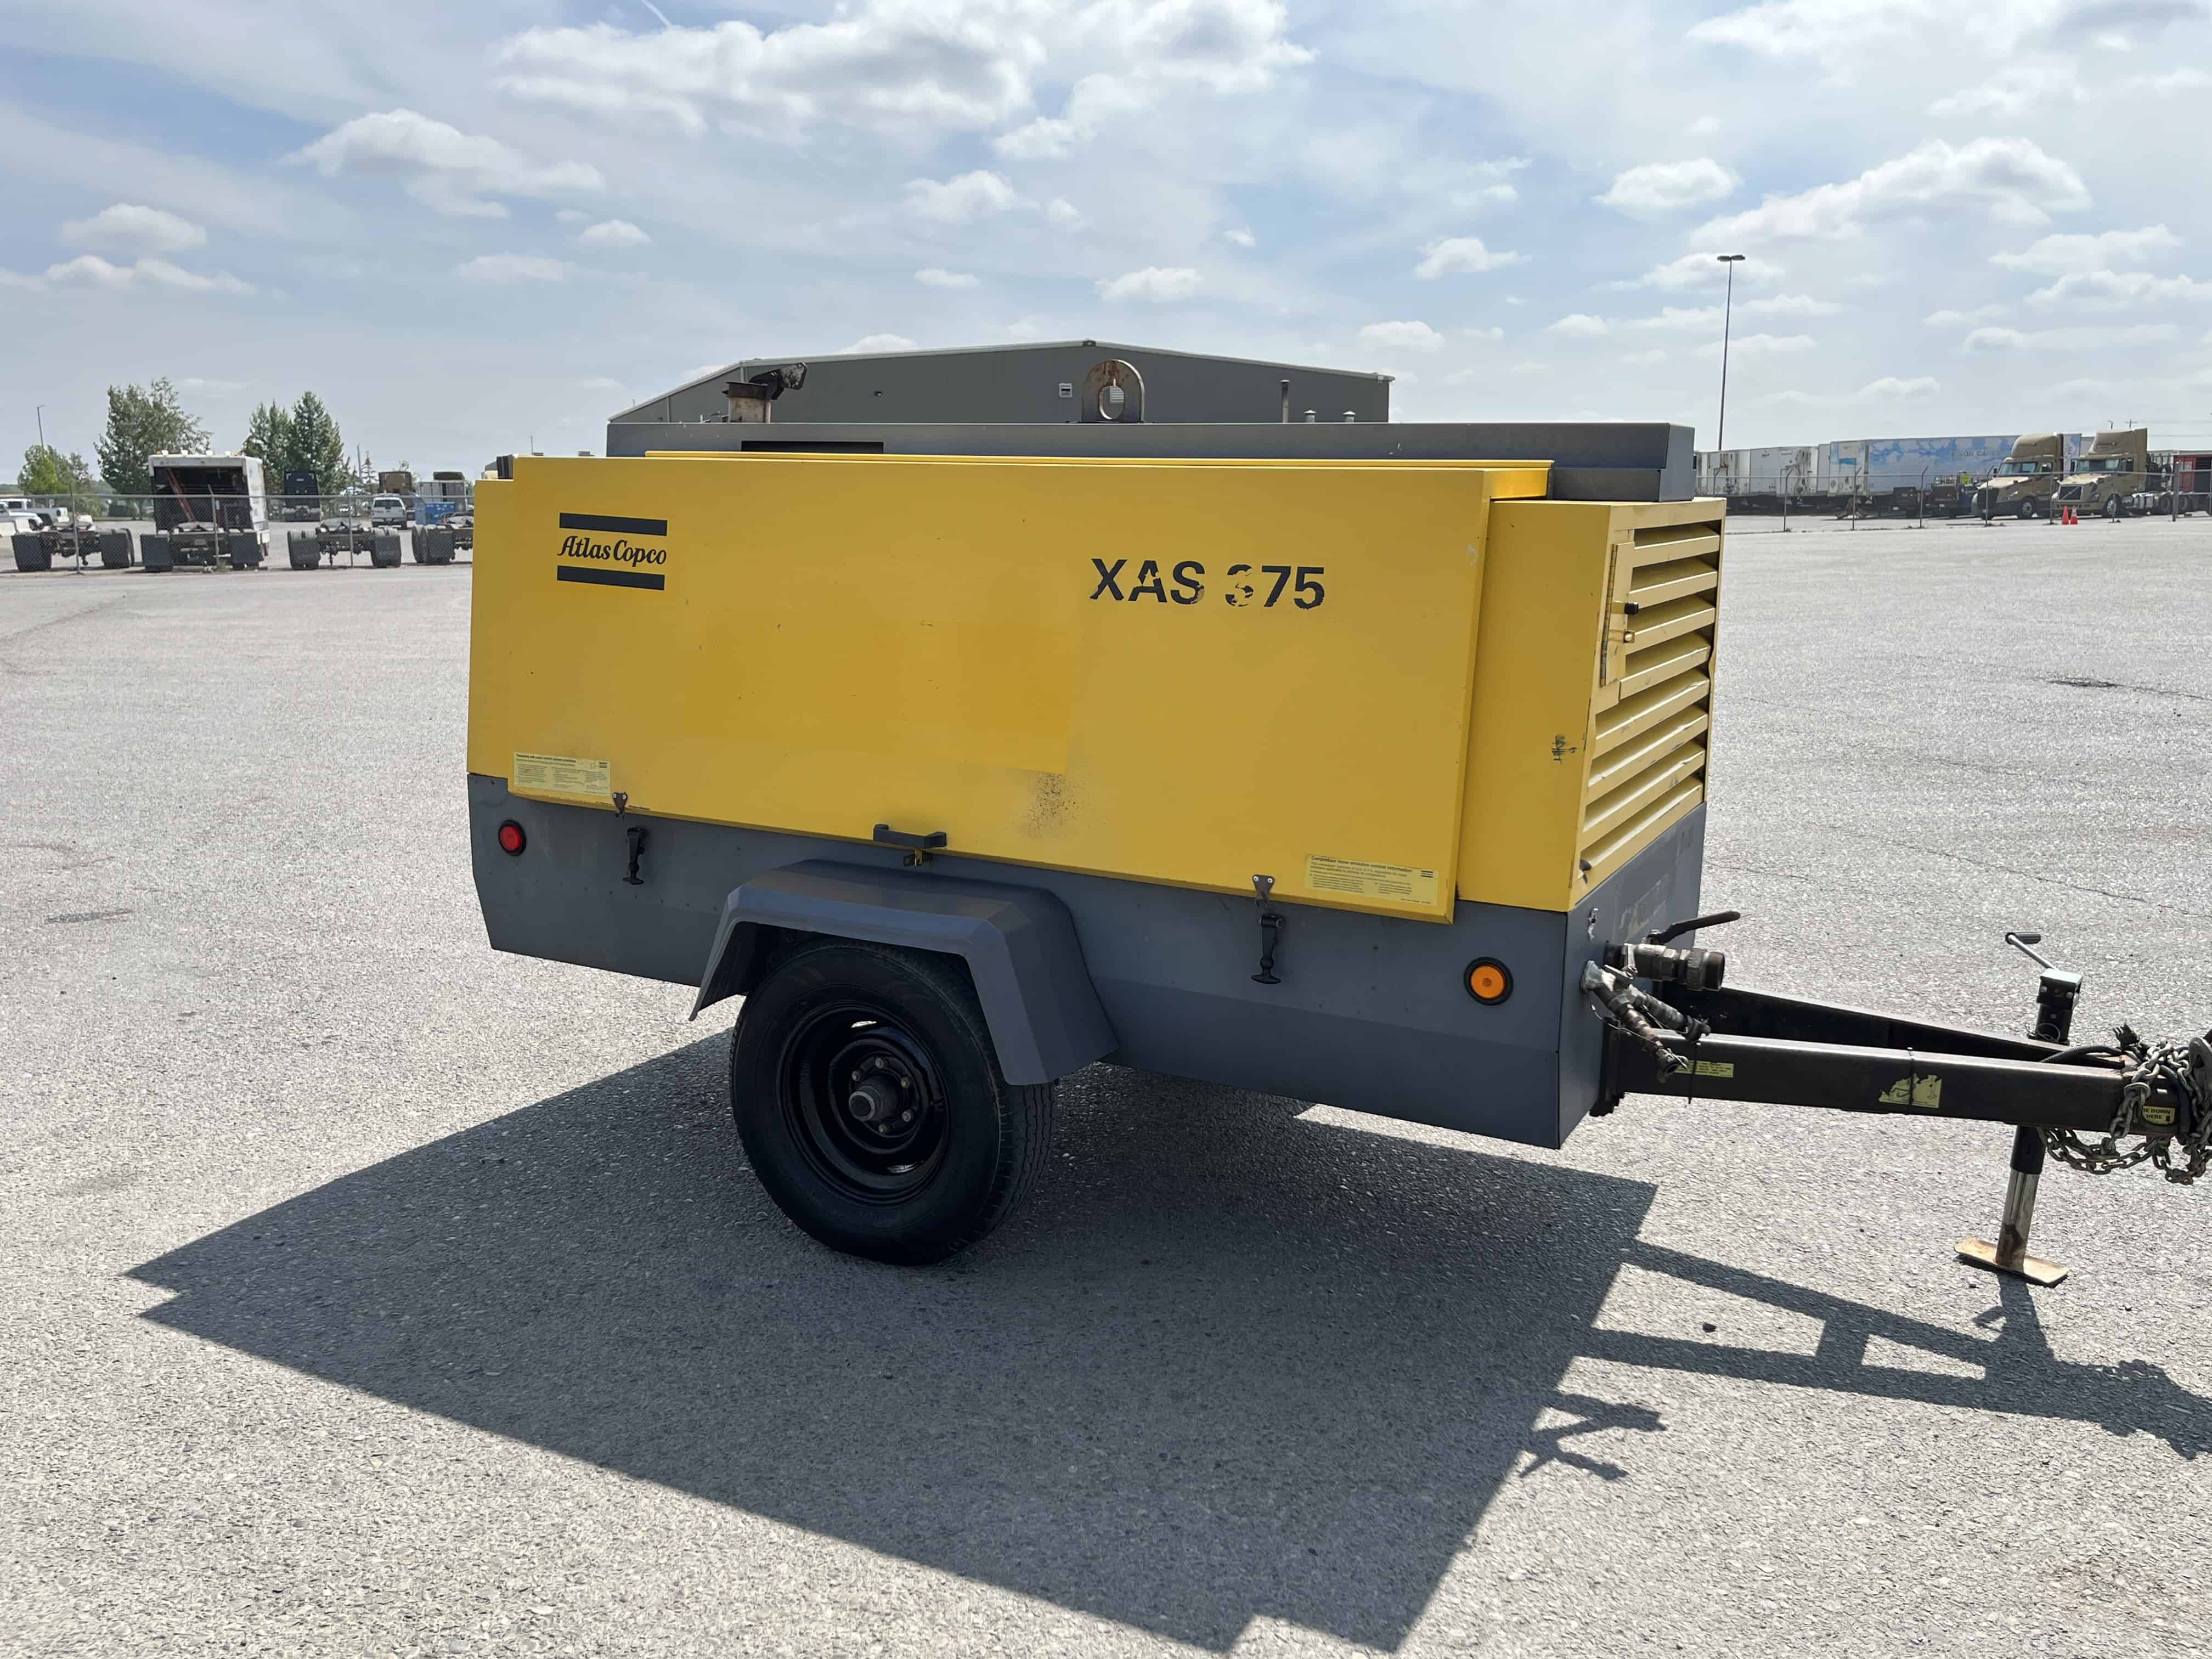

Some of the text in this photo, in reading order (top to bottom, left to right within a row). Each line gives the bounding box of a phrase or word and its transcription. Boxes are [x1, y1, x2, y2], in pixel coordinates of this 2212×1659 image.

[557, 535, 667, 567] Atlas Copco
[1090, 558, 1325, 610] XAS 375
